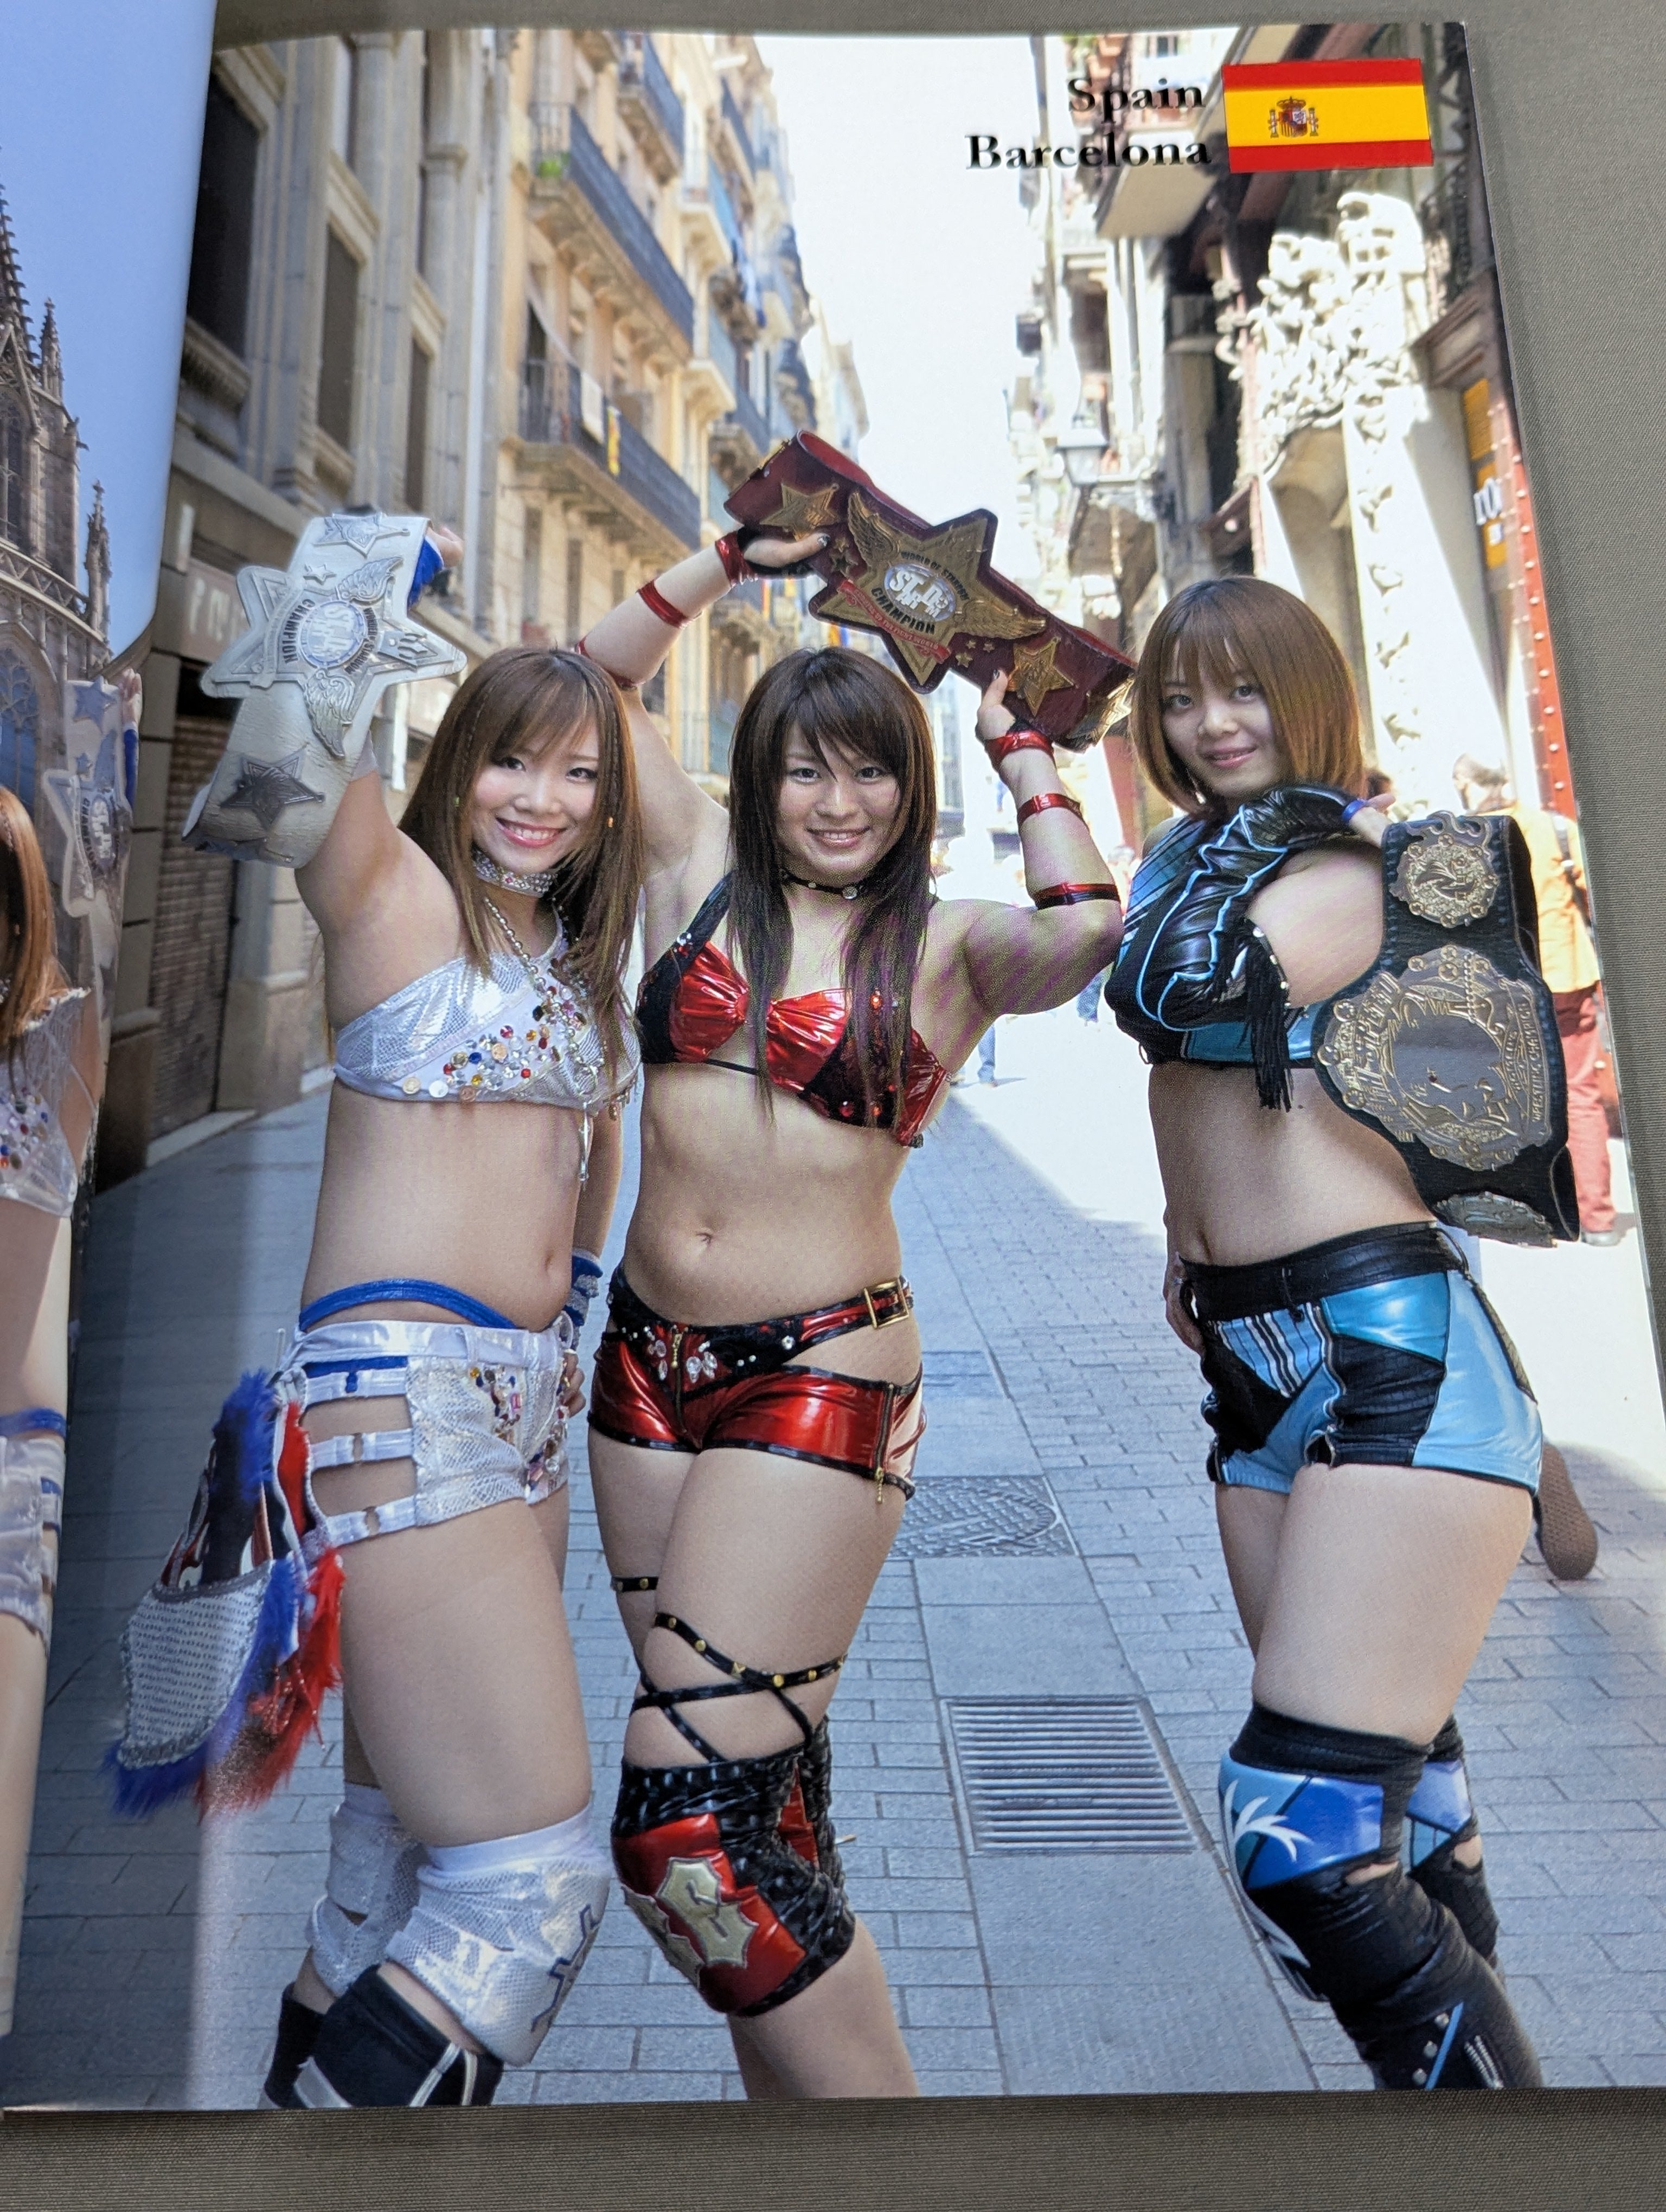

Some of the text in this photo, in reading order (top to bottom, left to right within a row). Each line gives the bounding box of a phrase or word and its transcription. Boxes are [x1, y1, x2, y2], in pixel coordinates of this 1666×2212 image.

[1067, 78, 1206, 124] Spain
[964, 131, 1212, 170] Barcelona
[282, 599, 316, 664] CHAMPION
[363, 607, 379, 636] WONDER
[871, 587, 935, 634] CHAMPION
[344, 642, 375, 675] STARDOM
[1518, 1003, 1541, 1061] CHAMPION
